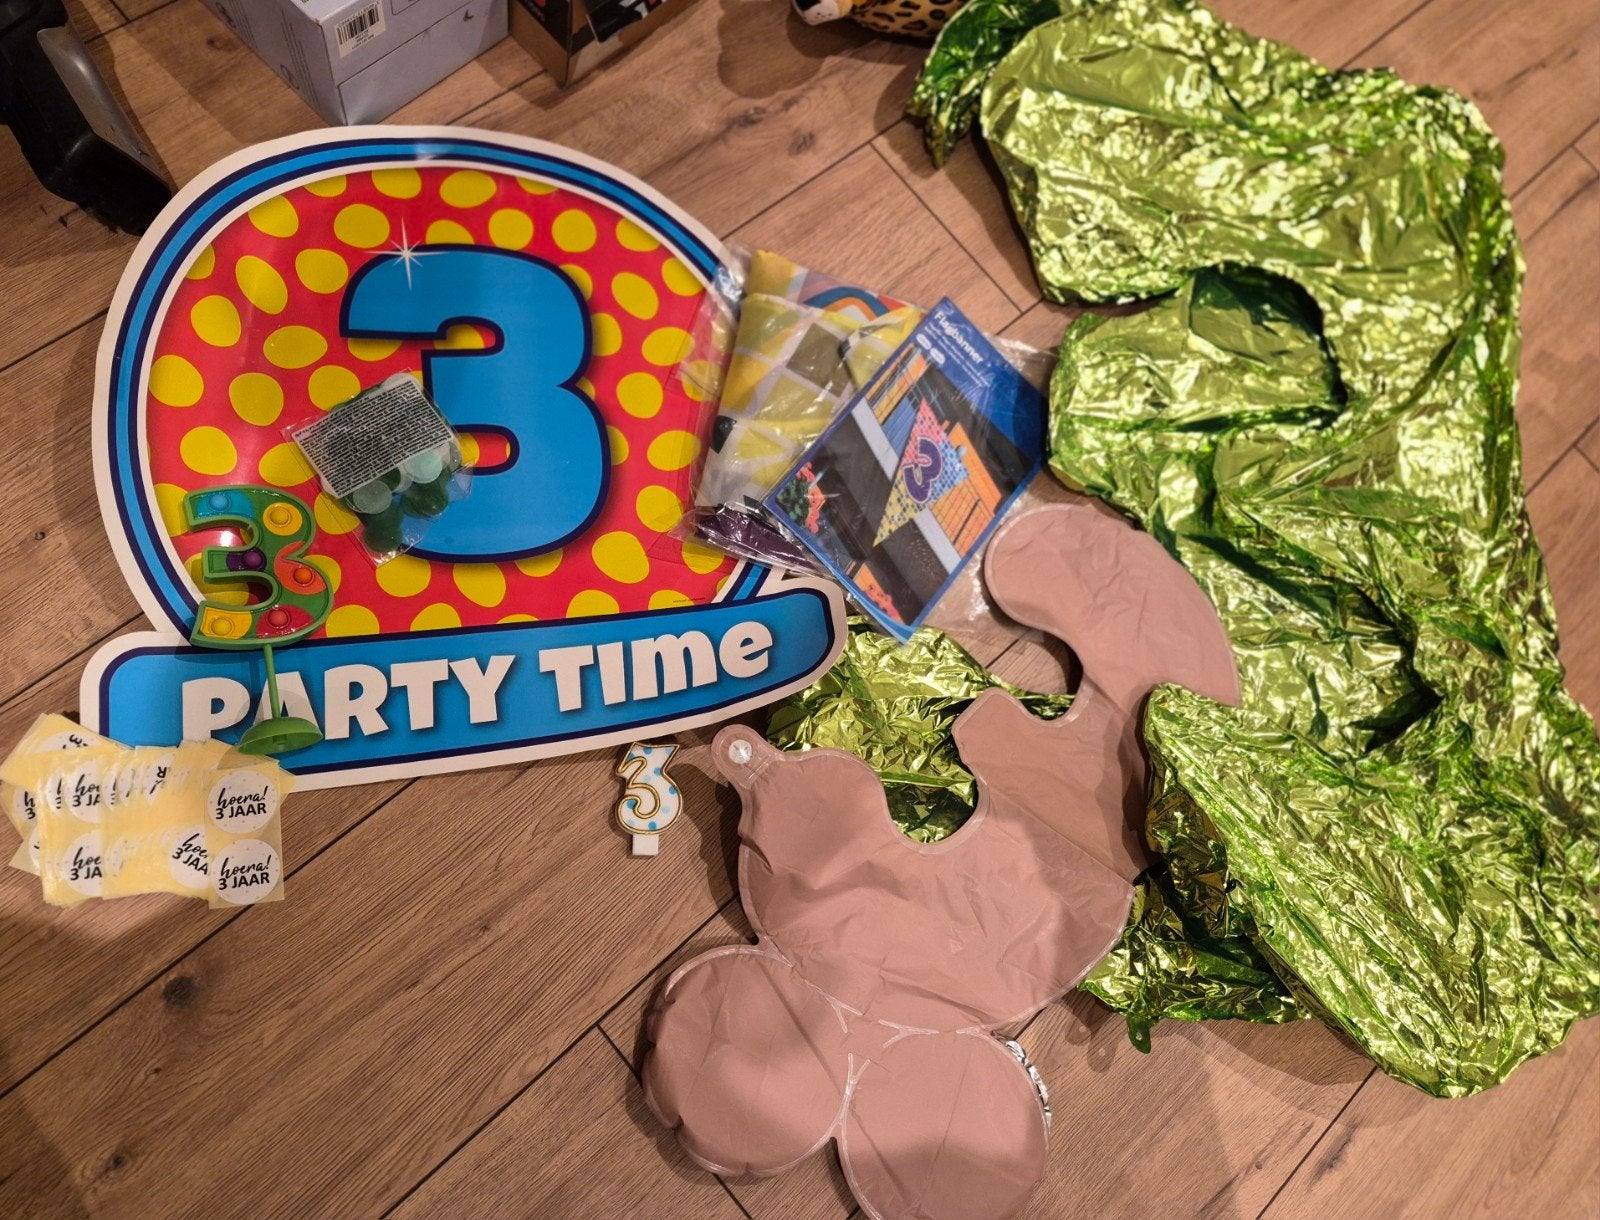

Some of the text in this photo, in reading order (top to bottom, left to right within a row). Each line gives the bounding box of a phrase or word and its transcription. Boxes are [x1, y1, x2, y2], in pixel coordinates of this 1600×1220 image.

[934, 311, 984, 364] Flagbanner
[339, 243, 612, 564] 3
[902, 436, 942, 503] 3
[184, 484, 335, 651] 3
[181, 655, 516, 741] PARTY
[217, 785, 268, 809] hoera!
[615, 741, 683, 835] 3
[72, 795, 82, 807] 3
[215, 802, 267, 820] 3 JAAR
[73, 847, 102, 869] hoe
[182, 833, 208, 858] hoe
[70, 866, 102, 880] 3 JA
[172, 847, 208, 875] 3 JAA
[220, 854, 271, 879] hoera!
[218, 872, 270, 890] 3 JAAR
